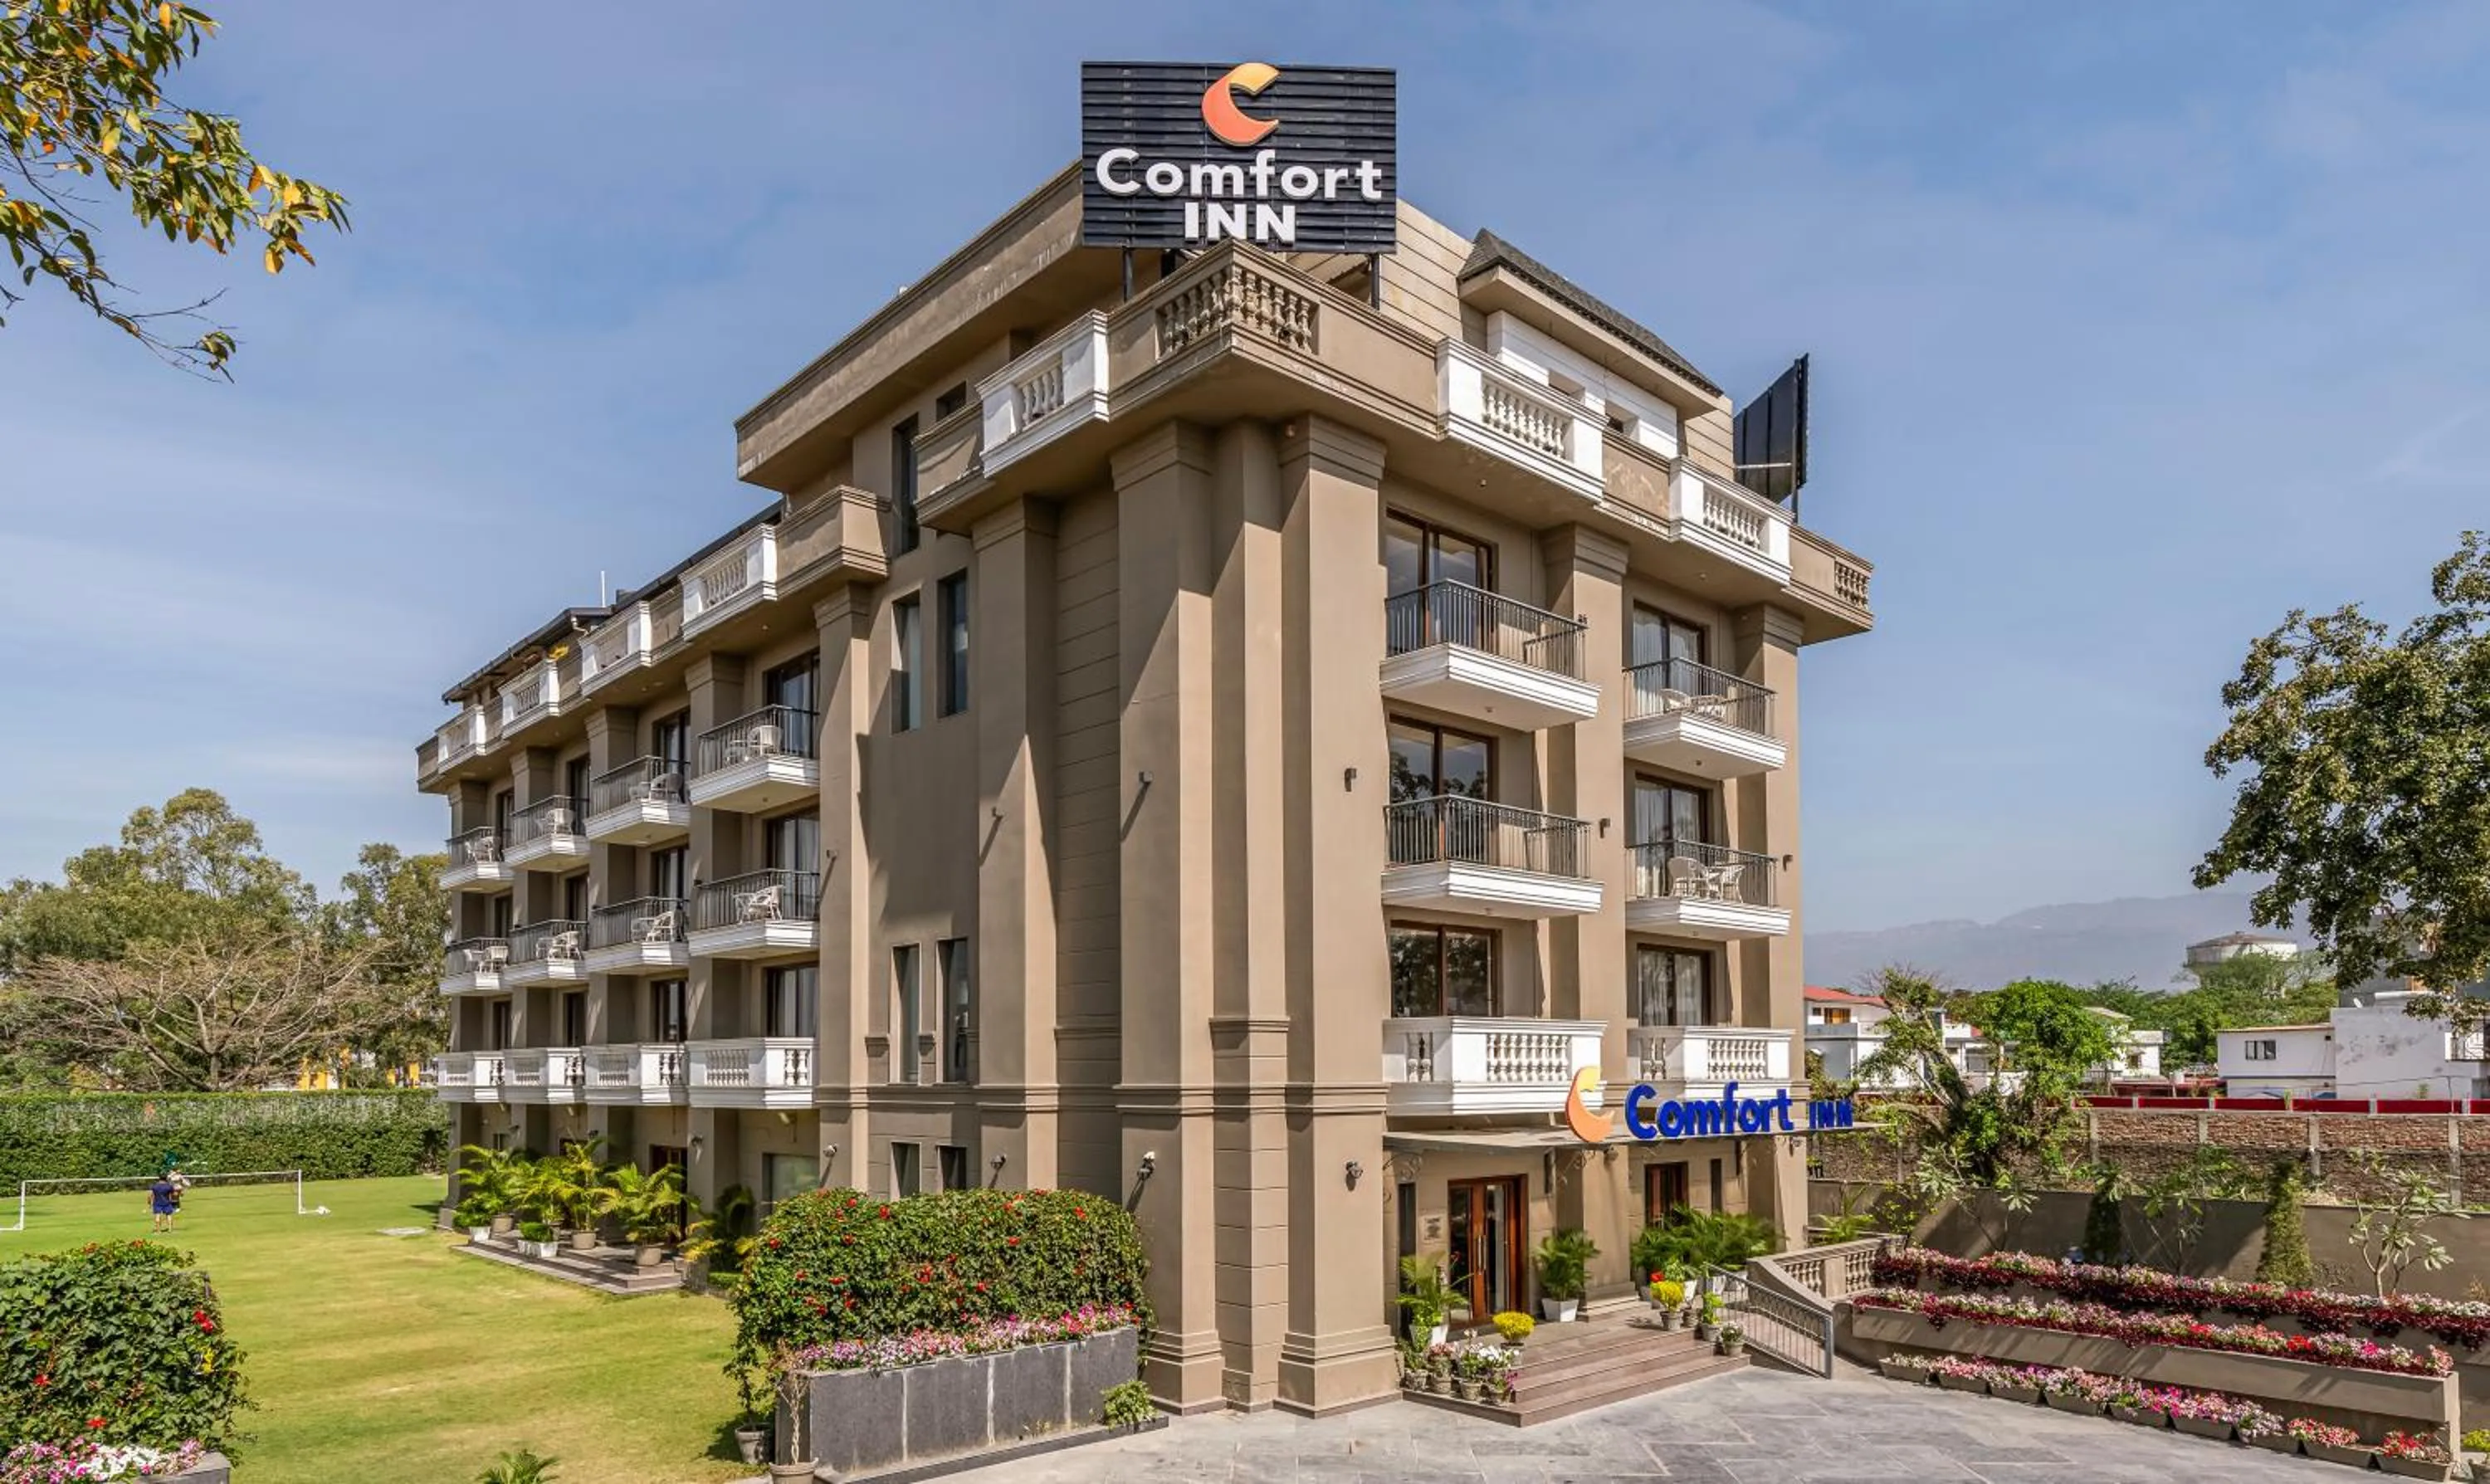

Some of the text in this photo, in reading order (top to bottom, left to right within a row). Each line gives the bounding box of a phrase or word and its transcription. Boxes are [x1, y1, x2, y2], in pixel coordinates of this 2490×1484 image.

[1096, 148, 1382, 200] Comfort
[1184, 202, 1296, 245] INN
[1624, 1081, 1794, 1140] Comfort
[1809, 1100, 1853, 1129] INN
